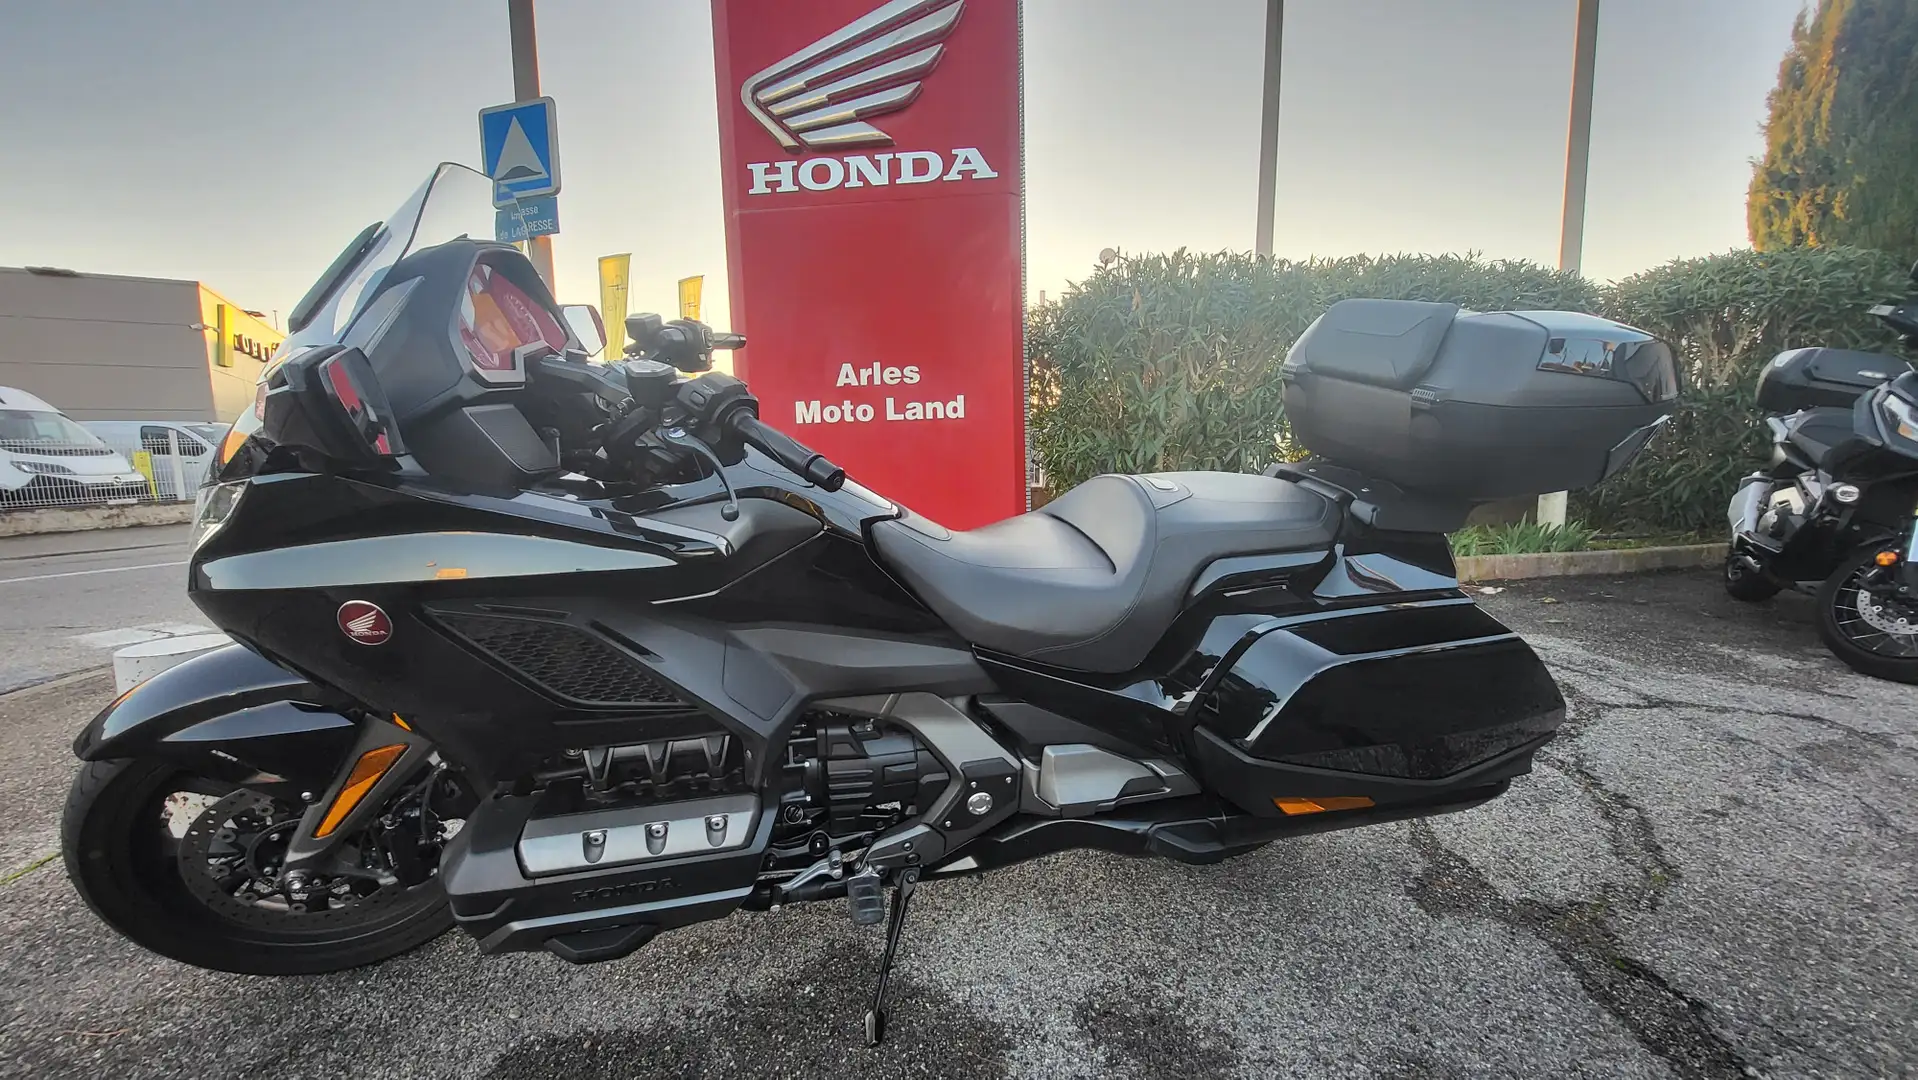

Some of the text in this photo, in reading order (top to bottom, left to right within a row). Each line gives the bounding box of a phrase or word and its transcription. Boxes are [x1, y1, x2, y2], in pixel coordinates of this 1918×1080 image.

[747, 147, 998, 195] HONDA
[836, 361, 921, 387] Arles
[795, 394, 965, 424] Moto Land
[571, 877, 675, 902] HONDA
